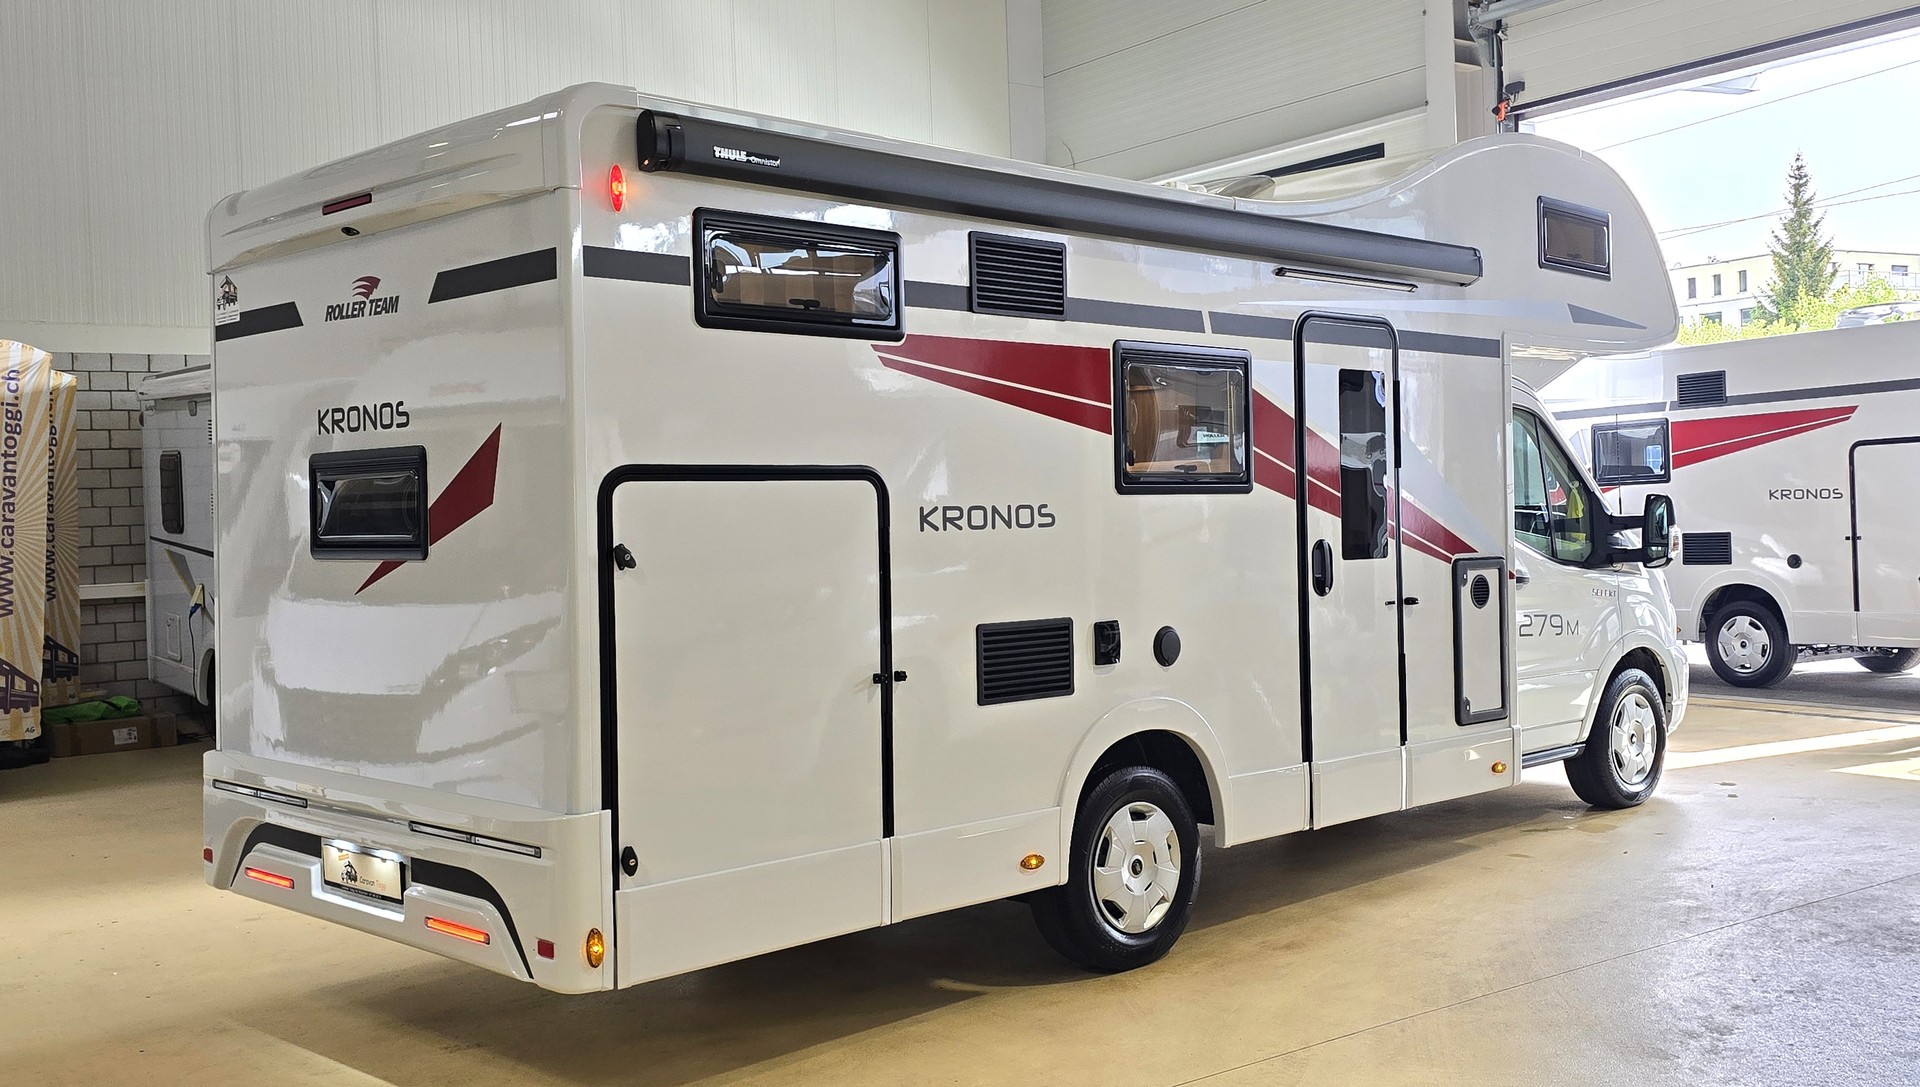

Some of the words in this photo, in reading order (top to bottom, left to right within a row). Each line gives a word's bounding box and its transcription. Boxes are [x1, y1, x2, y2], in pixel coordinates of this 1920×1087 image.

[713, 145, 747, 162] THULE
[325, 300, 367, 322] ROLLER
[368, 295, 400, 317] TEAM
[317, 400, 410, 435] KRONOS
[0, 369, 22, 618] www.caravantoggi.ch
[1768, 488, 1844, 501] KRONOS
[919, 503, 1056, 532] KRONOS
